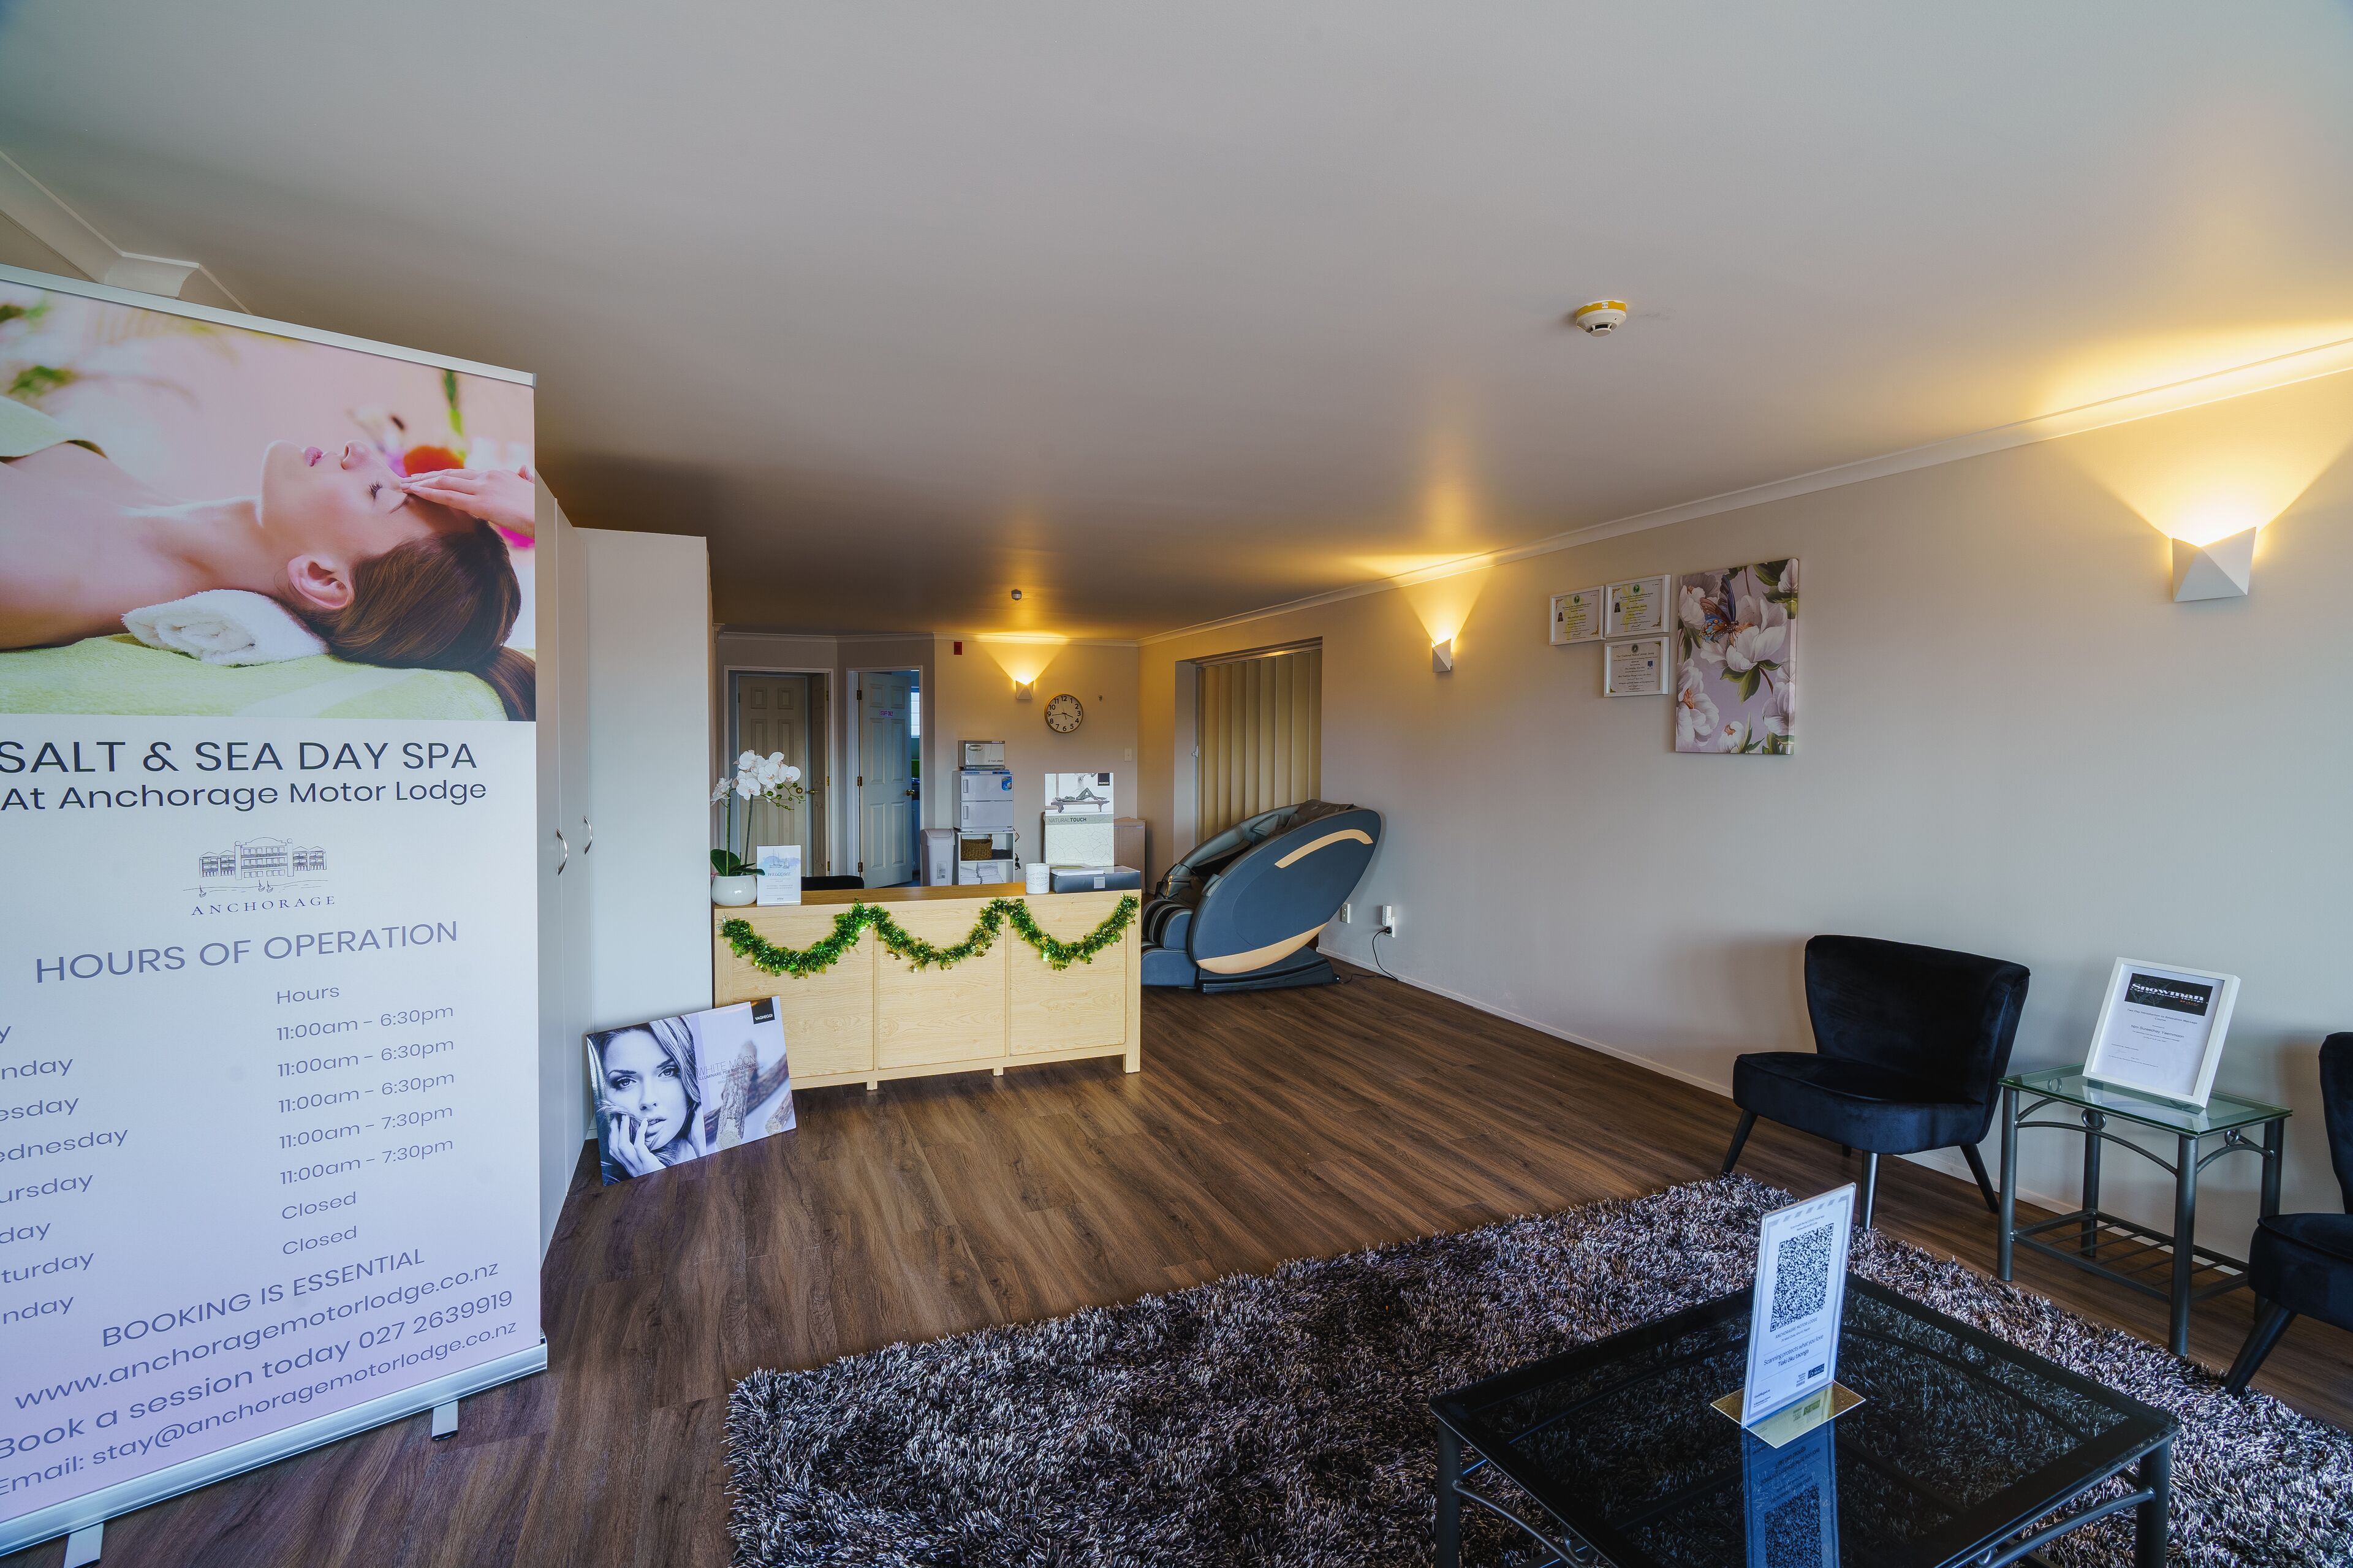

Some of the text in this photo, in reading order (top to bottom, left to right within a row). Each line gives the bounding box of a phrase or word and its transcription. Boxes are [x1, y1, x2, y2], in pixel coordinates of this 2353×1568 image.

[0, 741, 477, 773] SALT & SEA DAY SPA
[1, 780, 486, 811] At Anchorage Motor Lodge
[191, 896, 335, 915] ANCHORAGE
[37, 921, 456, 983] HOURS OF OPERATION
[278, 988, 339, 1004] Hours
[2132, 983, 2204, 1001] Snowman
[277, 1021, 357, 1040] 11:00am
[381, 1008, 453, 1026] 6:30pm
[278, 1056, 358, 1077] 11:00am
[382, 1041, 453, 1061] 6:30pm
[696, 1055, 756, 1077] WHITE MOON
[699, 1072, 722, 1081] ILLUMINARE
[731, 1062, 757, 1073] RISPLENDERE
[279, 1091, 358, 1113] 11:00am
[382, 1074, 453, 1094] 6:30pm
[279, 1125, 359, 1148] 11:00am
[382, 1108, 452, 1129] 7:30pm
[0, 1129, 128, 1162] dnesday
[280, 1160, 360, 1184] 11:00am
[382, 1141, 452, 1163] 7:30pm
[282, 1191, 355, 1219] Closed
[283, 1225, 356, 1254] Closed
[104, 1249, 425, 1347] BOOKING IS ESSENTIAL
[15, 1263, 498, 1409] www.anchoragemotorlodge.co.nz
[1808, 1317, 1818, 1325] LODGE
[1764, 1354, 1782, 1366] Scanning
[1782, 1346, 1799, 1358] protects
[1799, 1341, 1808, 1350] what
[1778, 1358, 1787, 1367] Tiaki
[1795, 1349, 1809, 1358] taonga
[0, 1291, 512, 1459] Book a session today 027 2639919
[93, 1322, 516, 1464] stay@anchoragemotorlodge.co.nz
